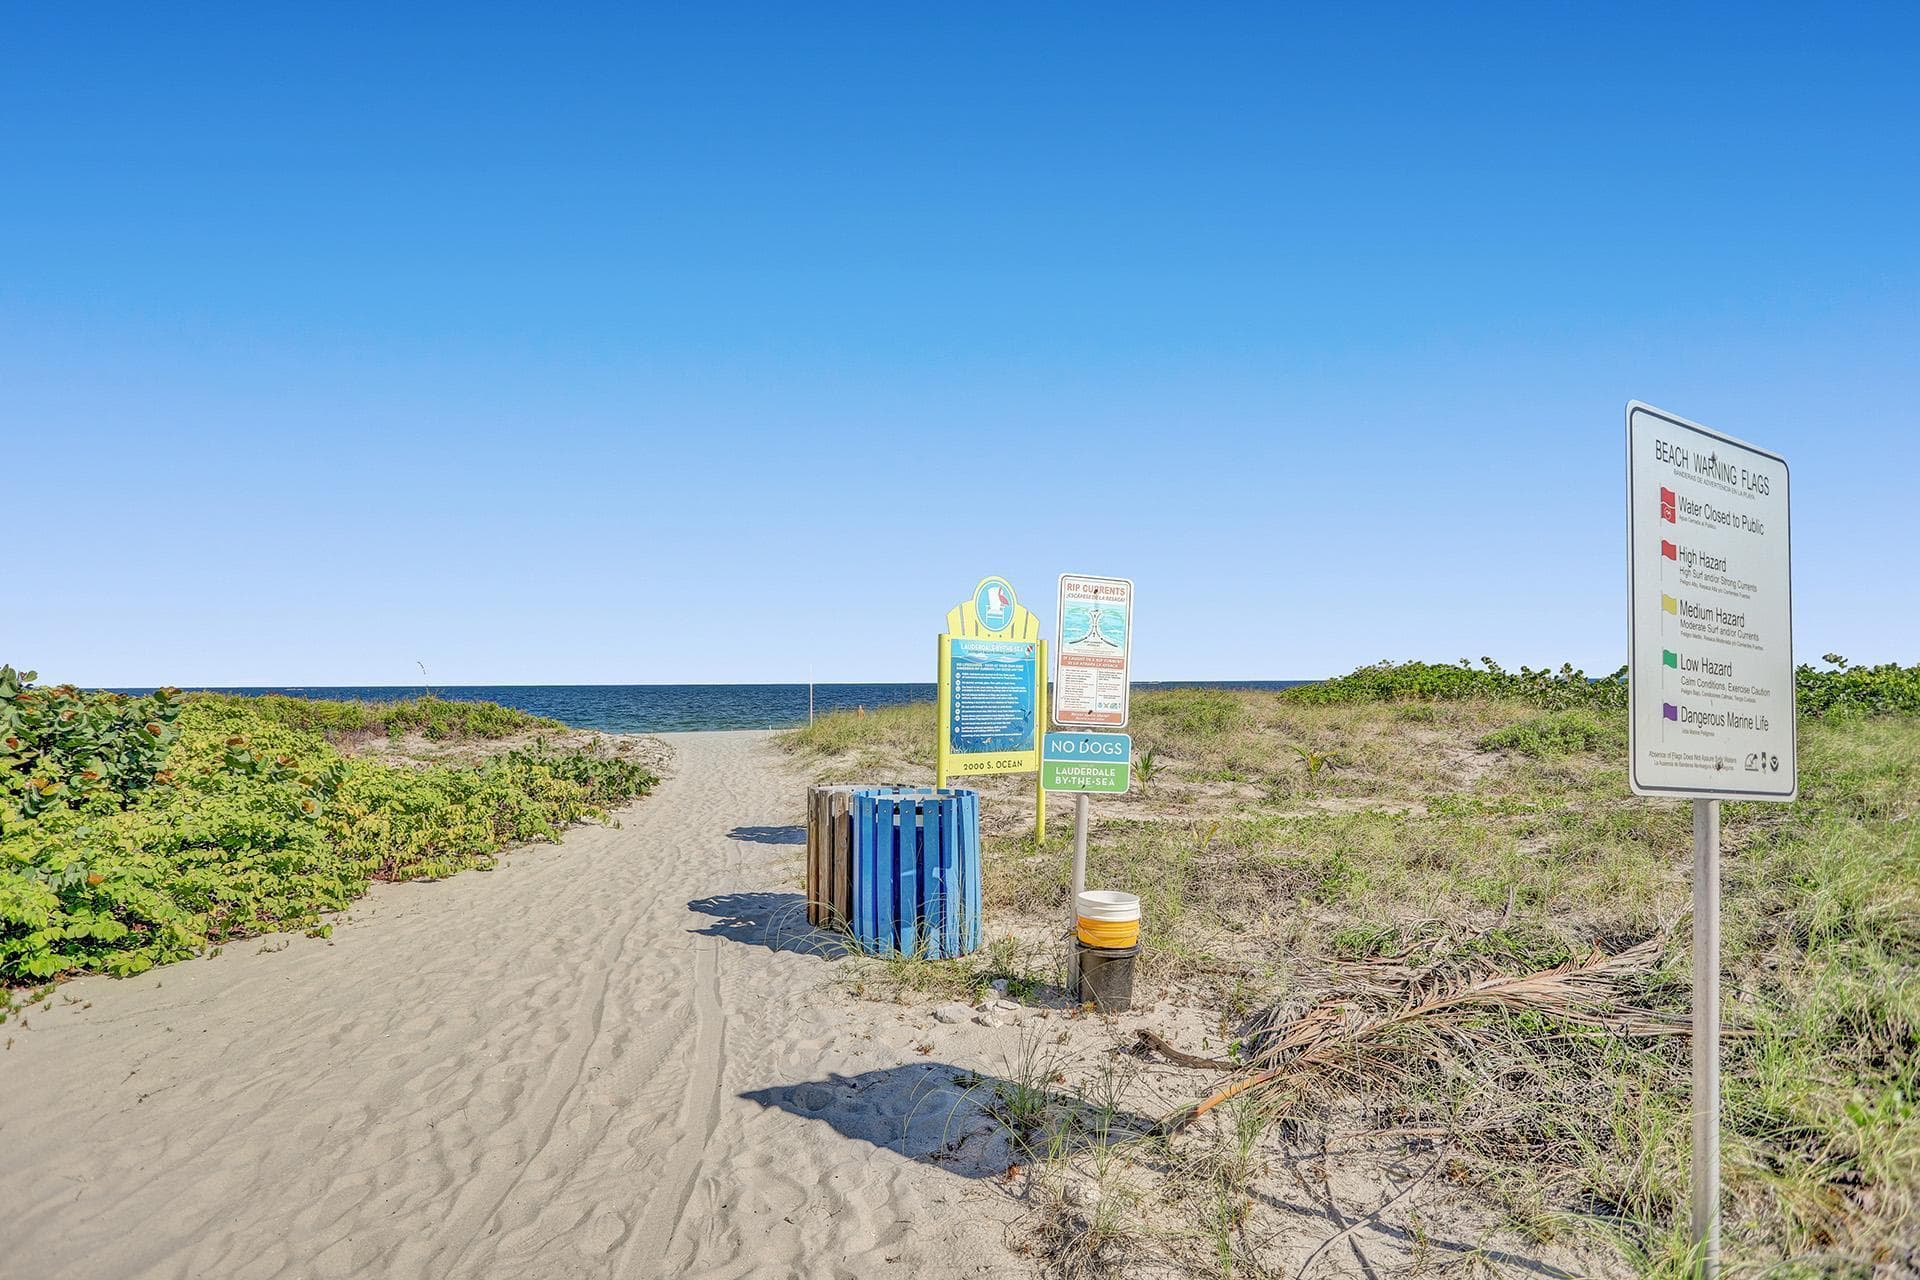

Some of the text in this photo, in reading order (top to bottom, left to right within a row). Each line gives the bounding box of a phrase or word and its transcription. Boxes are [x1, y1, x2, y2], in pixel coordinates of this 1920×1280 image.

[1655, 439, 1770, 496] BEACH WARNING FLAGS
[1678, 495, 1765, 536] Water Closed to Public
[1679, 545, 1727, 573] High Hazard
[1066, 583, 1126, 596] RIP CURRENTS
[1680, 567, 1692, 578] High
[1693, 569, 1703, 579] Surf
[1720, 575, 1737, 589] Strong
[1737, 580, 1758, 592] Currents
[1680, 599, 1745, 628] Medium Hazard
[1680, 619, 1706, 632] Moderate
[1707, 623, 1719, 634] Surf
[1737, 629, 1760, 641] Currents
[1680, 653, 1732, 677] Low Hazard
[1680, 675, 1696, 686] Calm
[1728, 682, 1751, 694] Exercise
[1751, 686, 1771, 696] Caution
[1680, 705, 1769, 731] Dangerous Marine Life
[1051, 740, 1122, 755] NO DOGS
[963, 760, 1023, 771] 2000 S. OCEAN
[1055, 767, 1116, 777] LAUDERDALE
